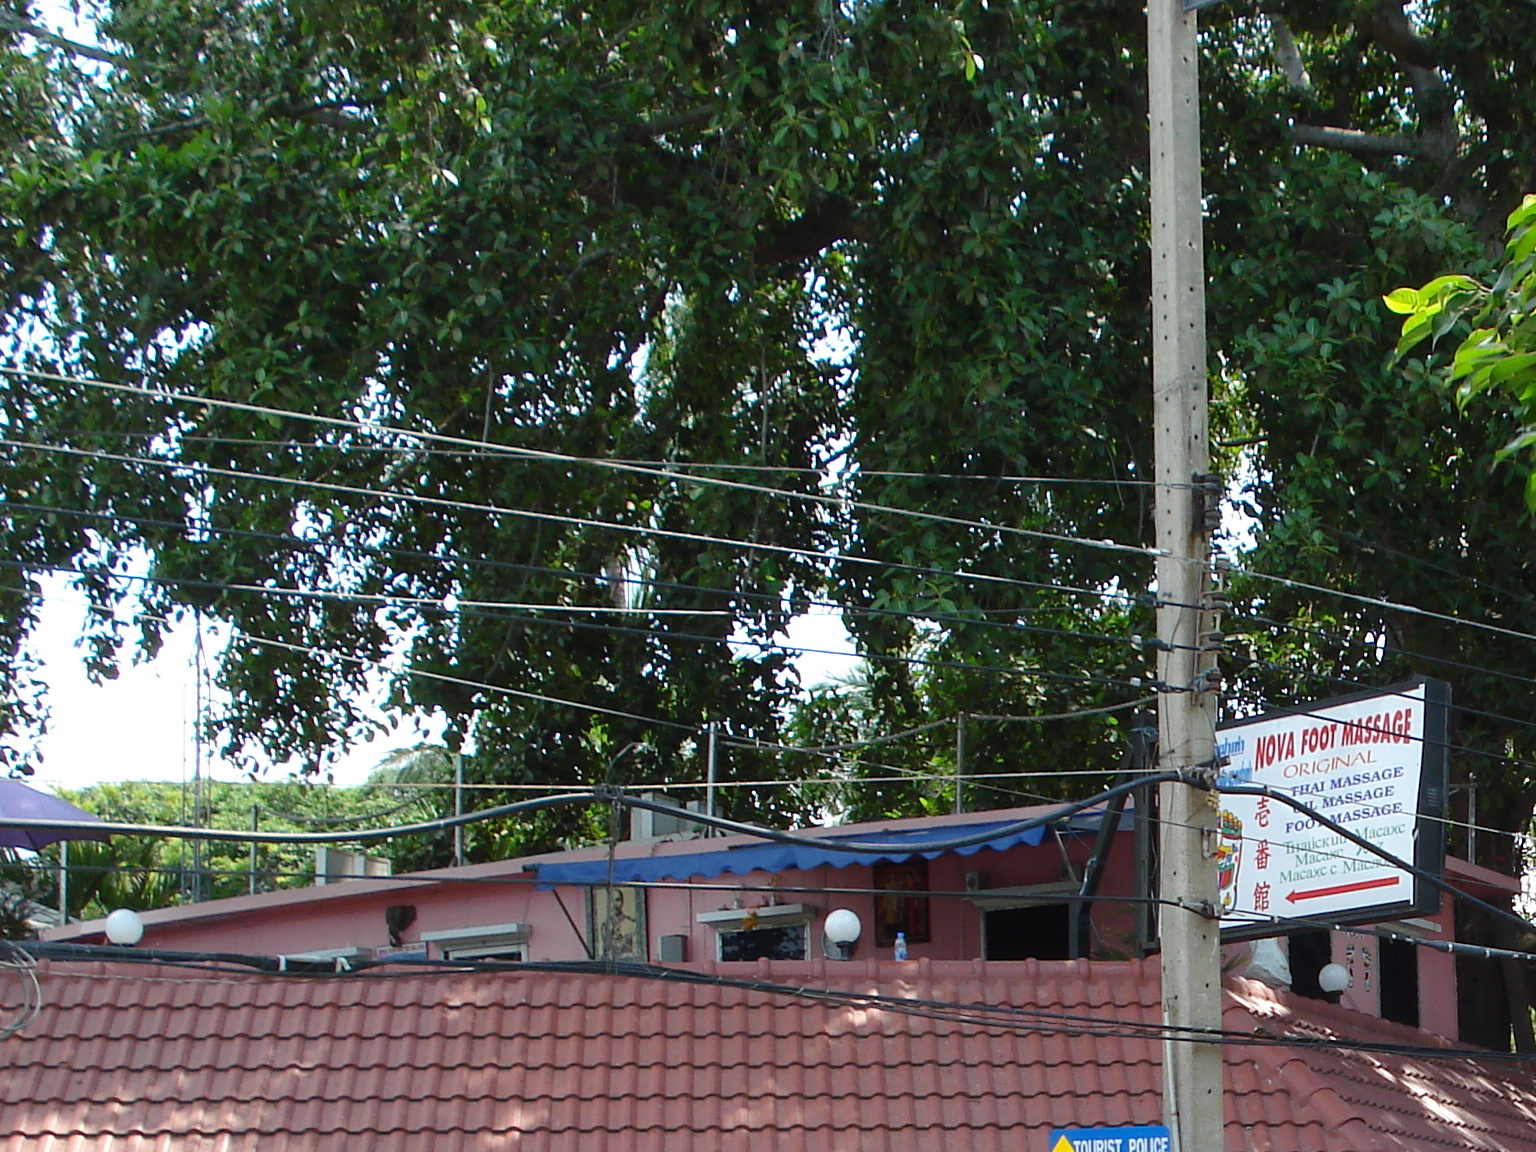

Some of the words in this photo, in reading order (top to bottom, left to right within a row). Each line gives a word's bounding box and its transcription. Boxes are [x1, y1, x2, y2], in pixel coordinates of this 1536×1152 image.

[1255, 731, 1295, 772] NOVA
[1301, 724, 1338, 756] FOOT
[1341, 708, 1412, 747] MASSAGE
[1283, 750, 1377, 779] ORIGINAL
[1292, 782, 1325, 797] THAI
[1329, 766, 1404, 790] MASSAGE
[1322, 785, 1395, 809] MASSAGE
[1329, 802, 1403, 825] MASSAGE
